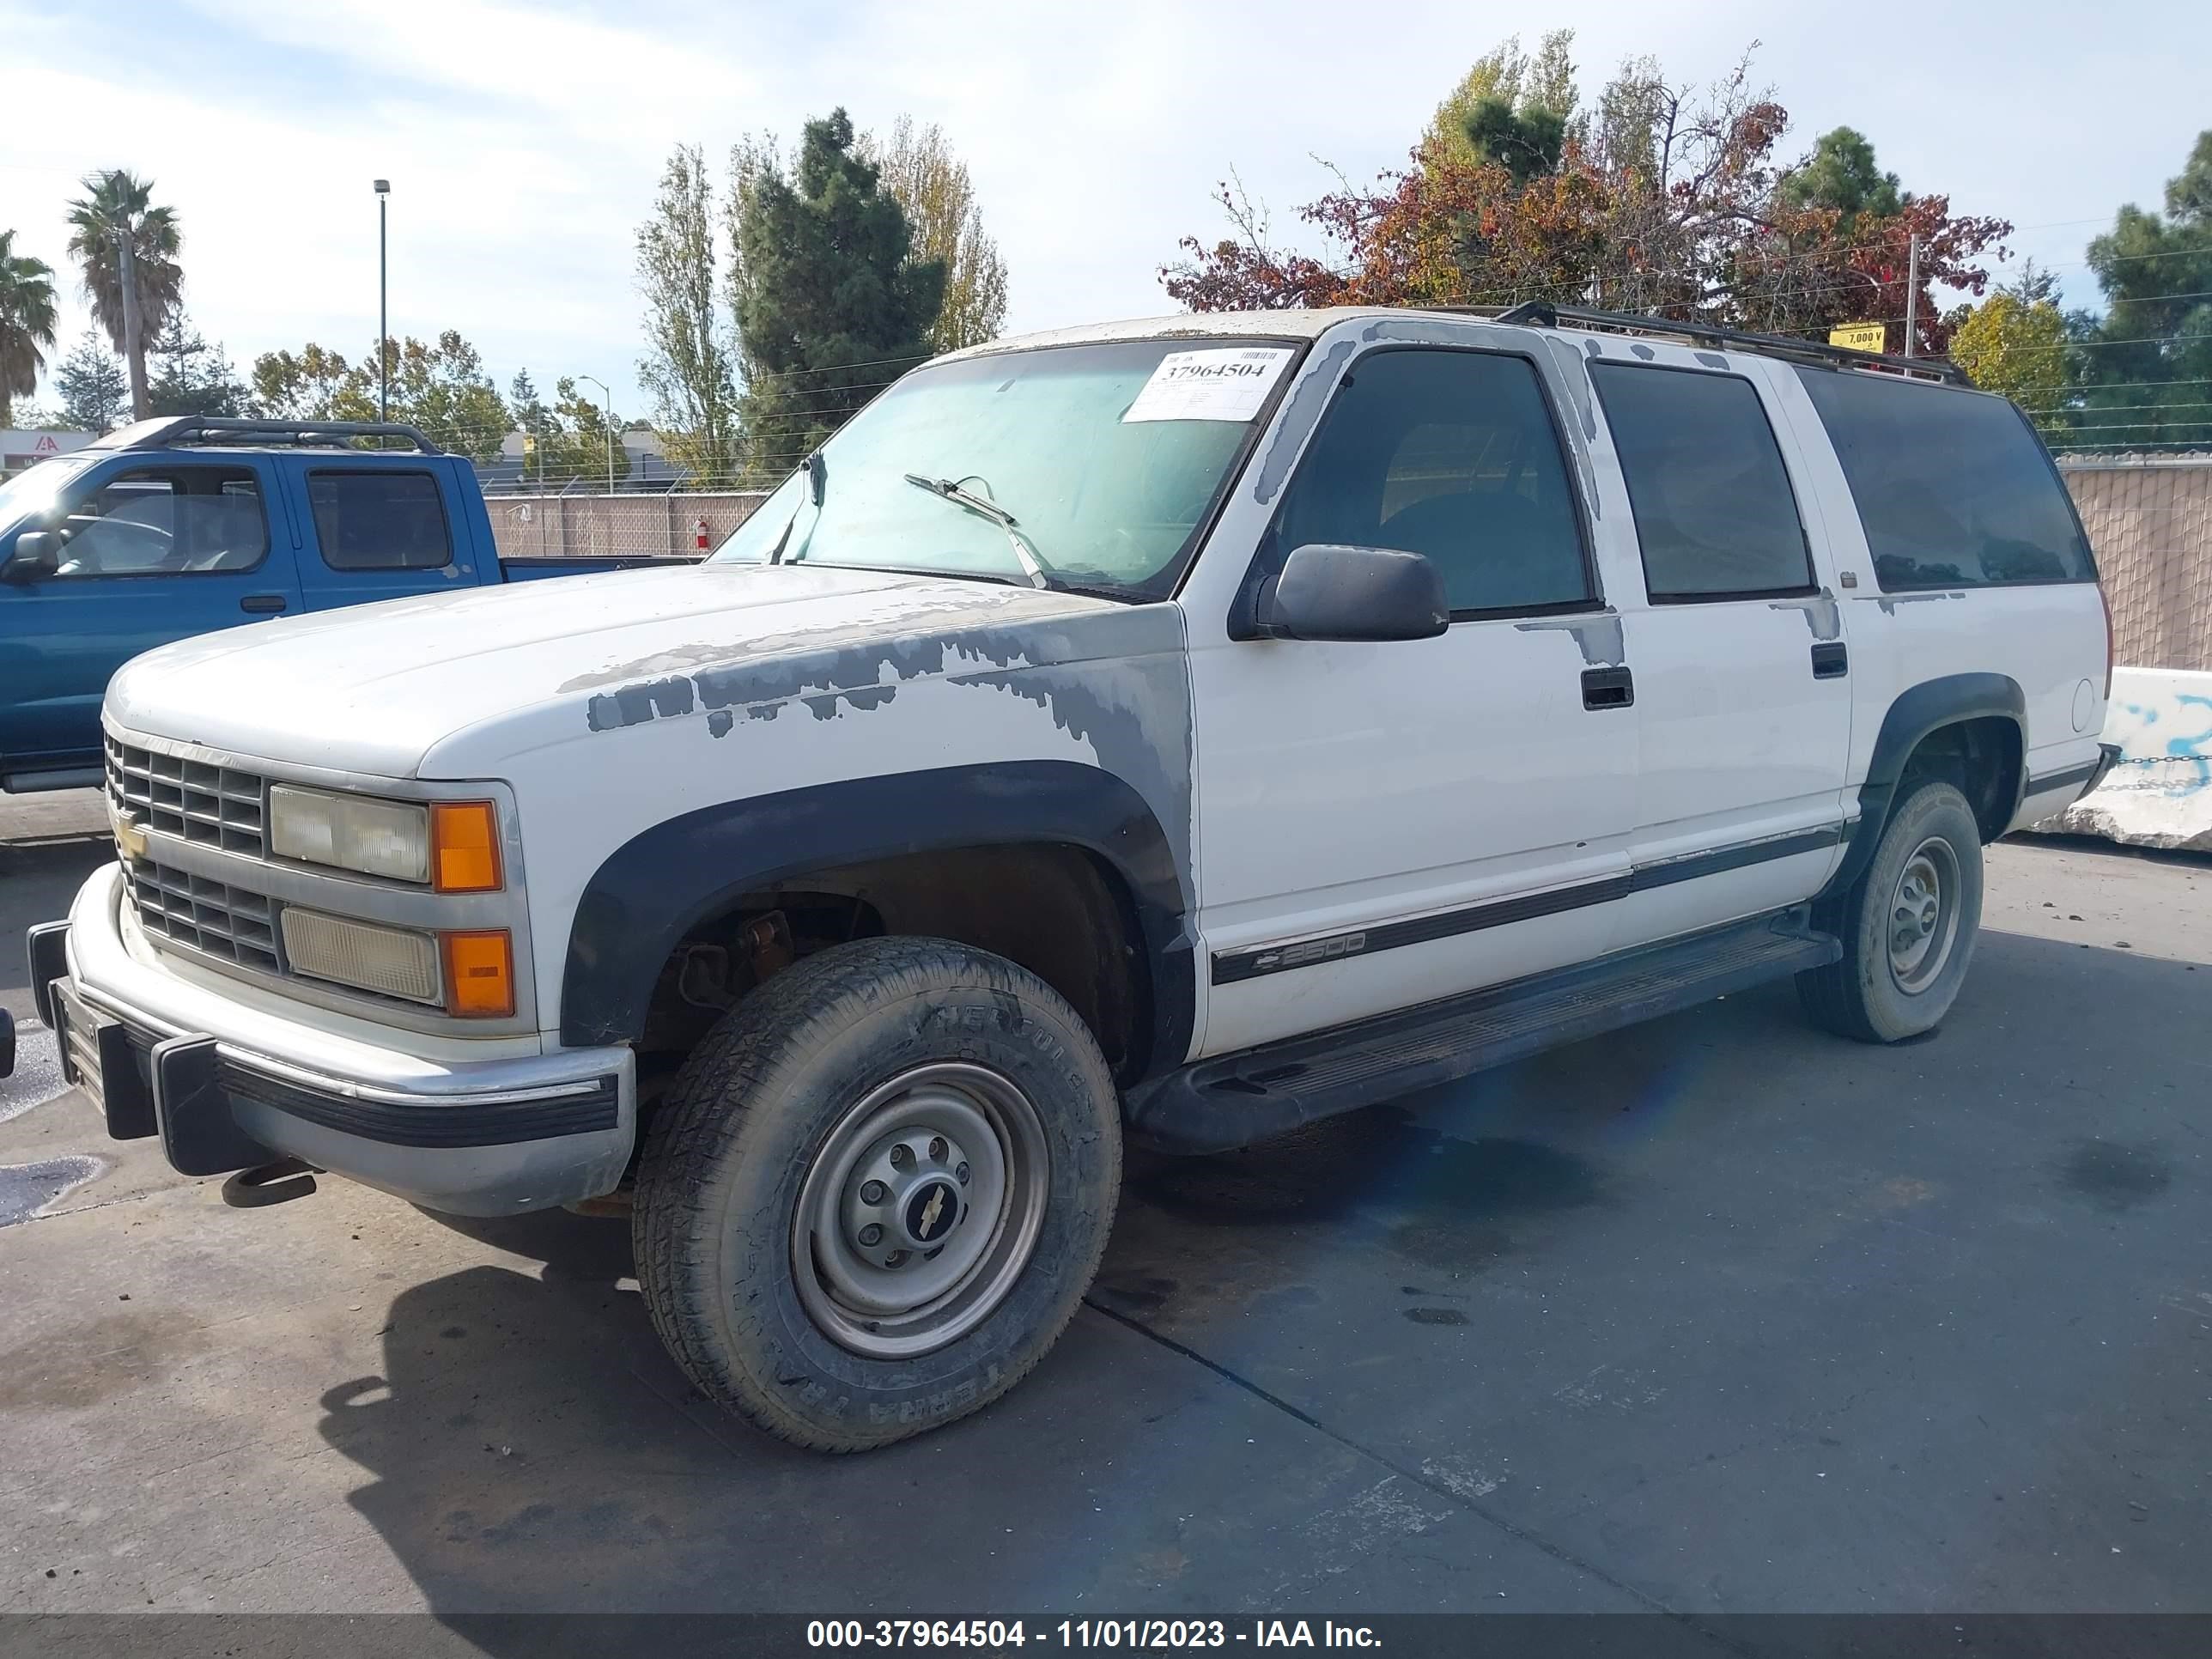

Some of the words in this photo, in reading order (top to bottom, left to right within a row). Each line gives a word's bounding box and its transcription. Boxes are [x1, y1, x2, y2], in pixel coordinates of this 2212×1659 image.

[1850, 332, 1873, 344] 7,000
[1876, 331, 1881, 341] V
[1162, 363, 1266, 380] 37964504
[1281, 933, 1365, 966] 2500
